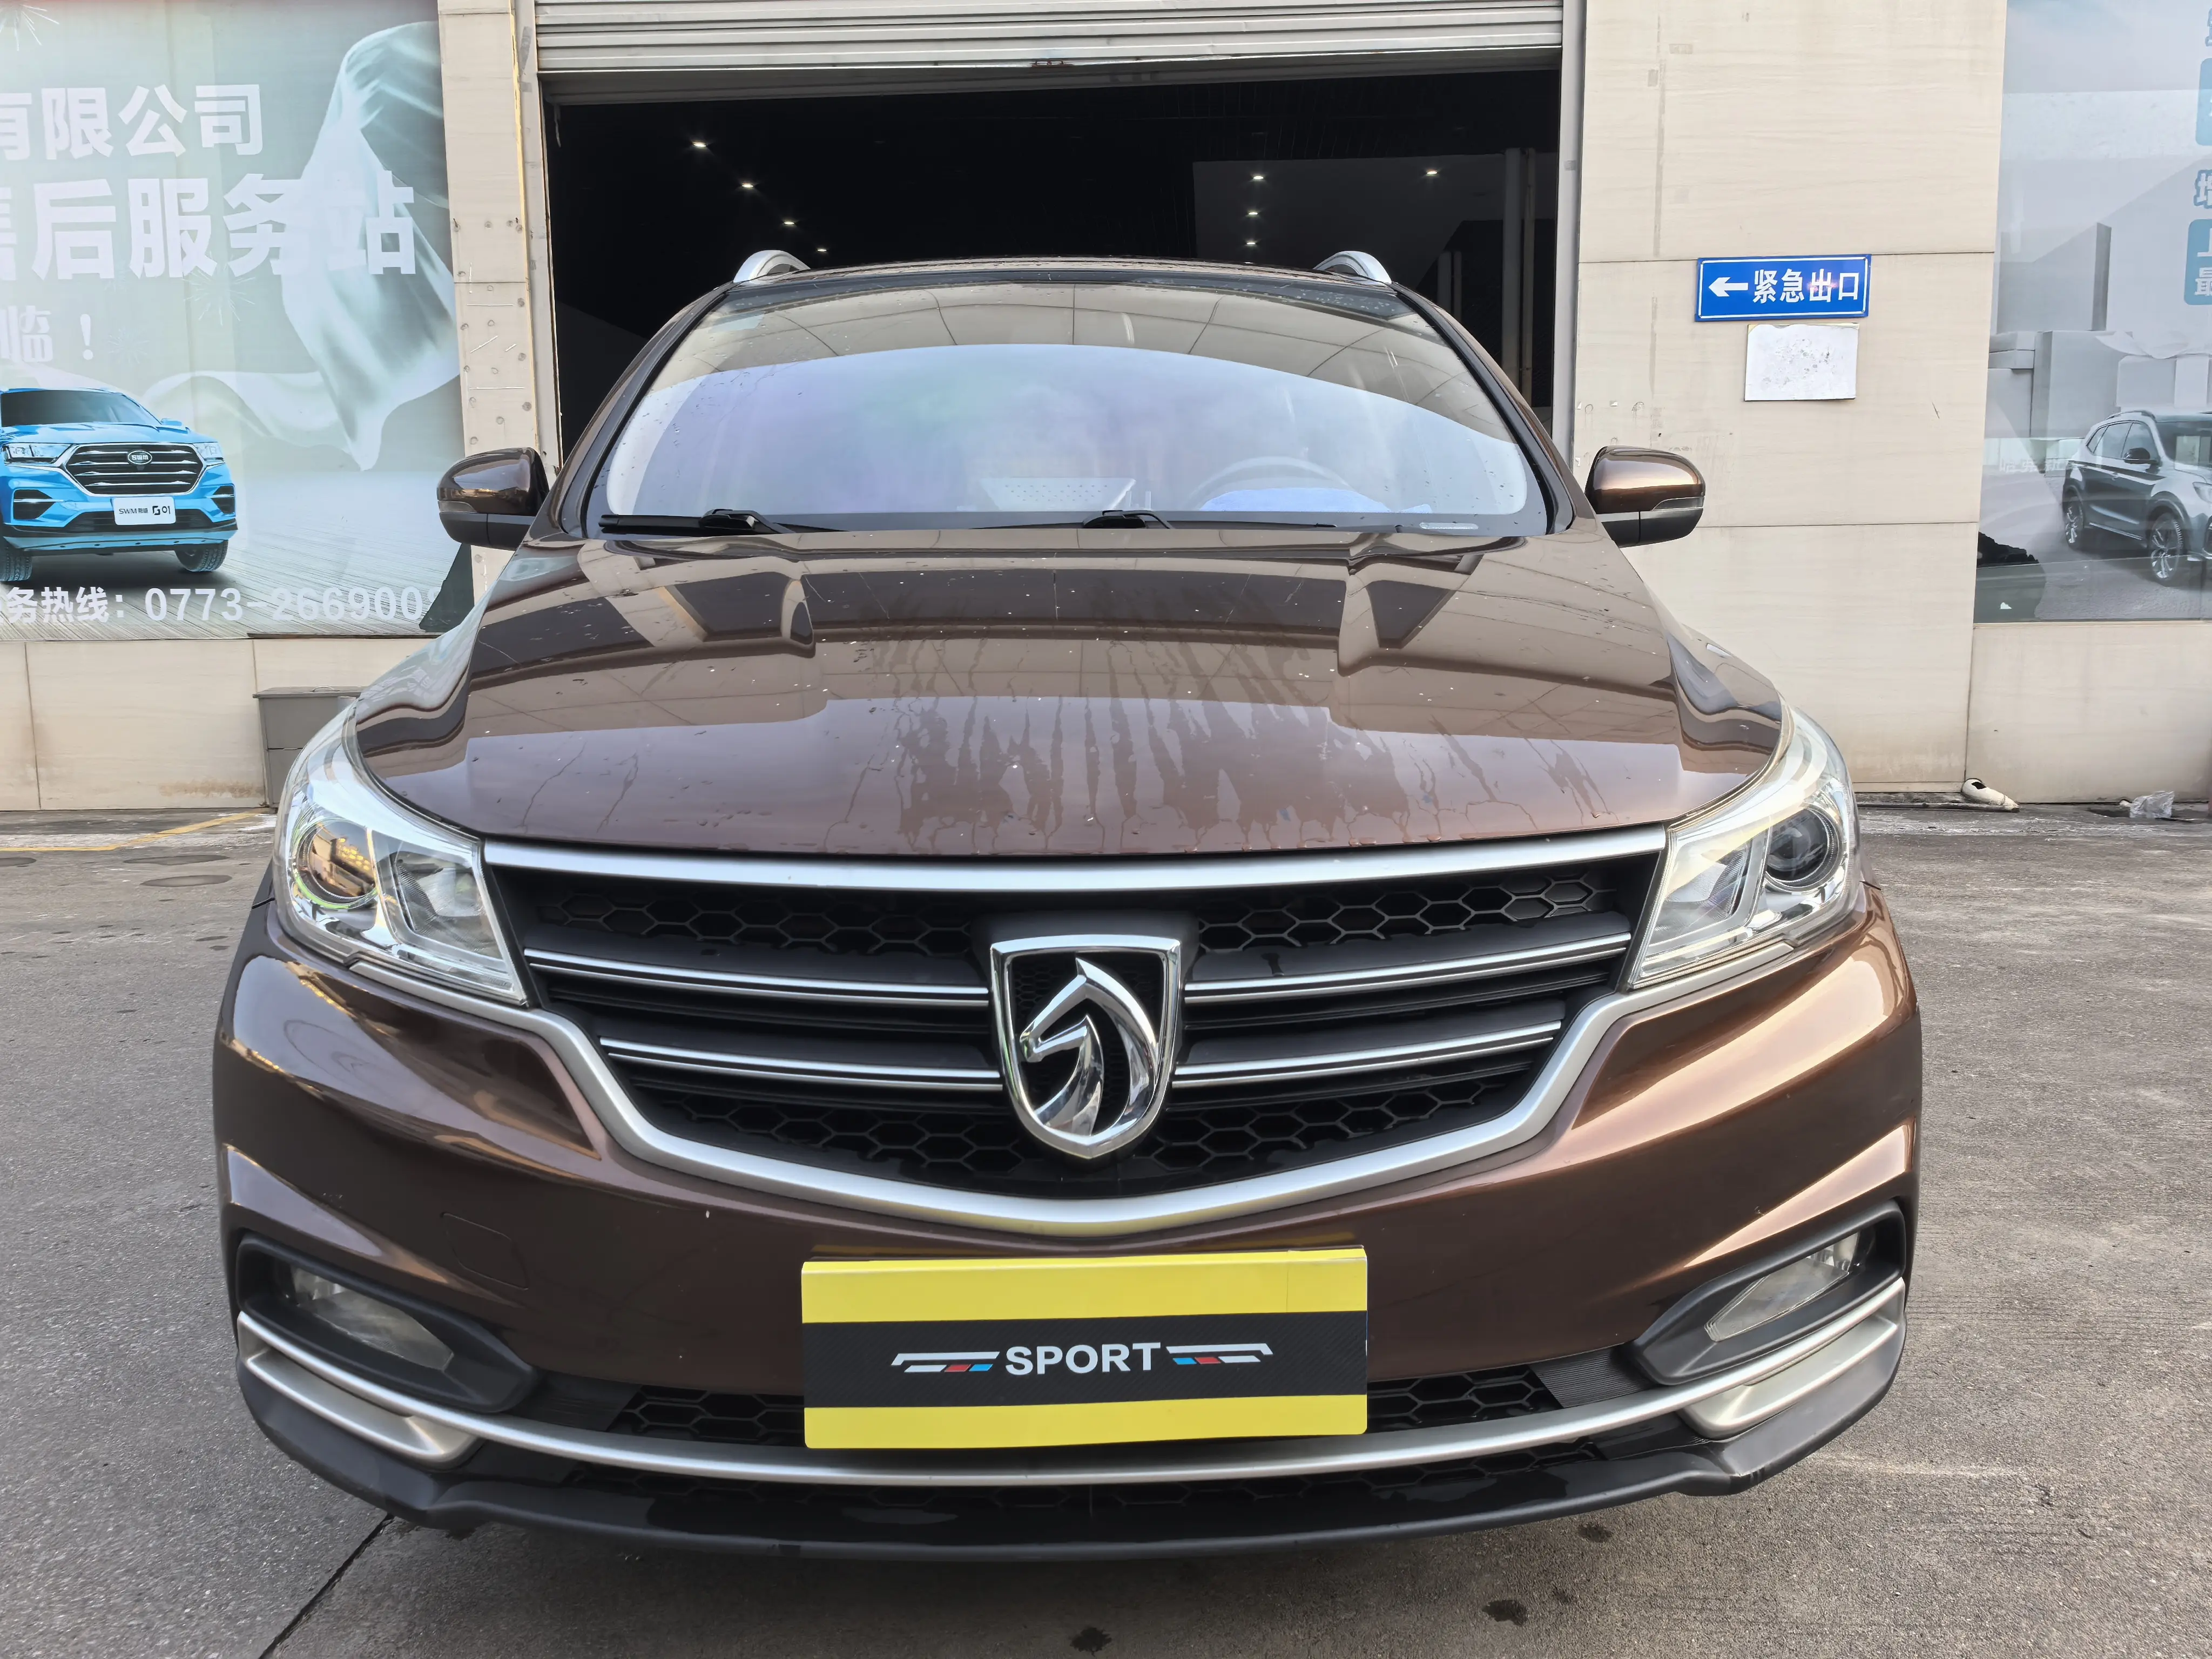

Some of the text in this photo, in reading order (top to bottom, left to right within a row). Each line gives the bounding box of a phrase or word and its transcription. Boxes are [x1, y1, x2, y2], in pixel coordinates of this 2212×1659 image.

[0, 171, 416, 282] 后服务站
[1752, 268, 1859, 303] 紧急出口
[1005, 1343, 1161, 1375] SPORT
